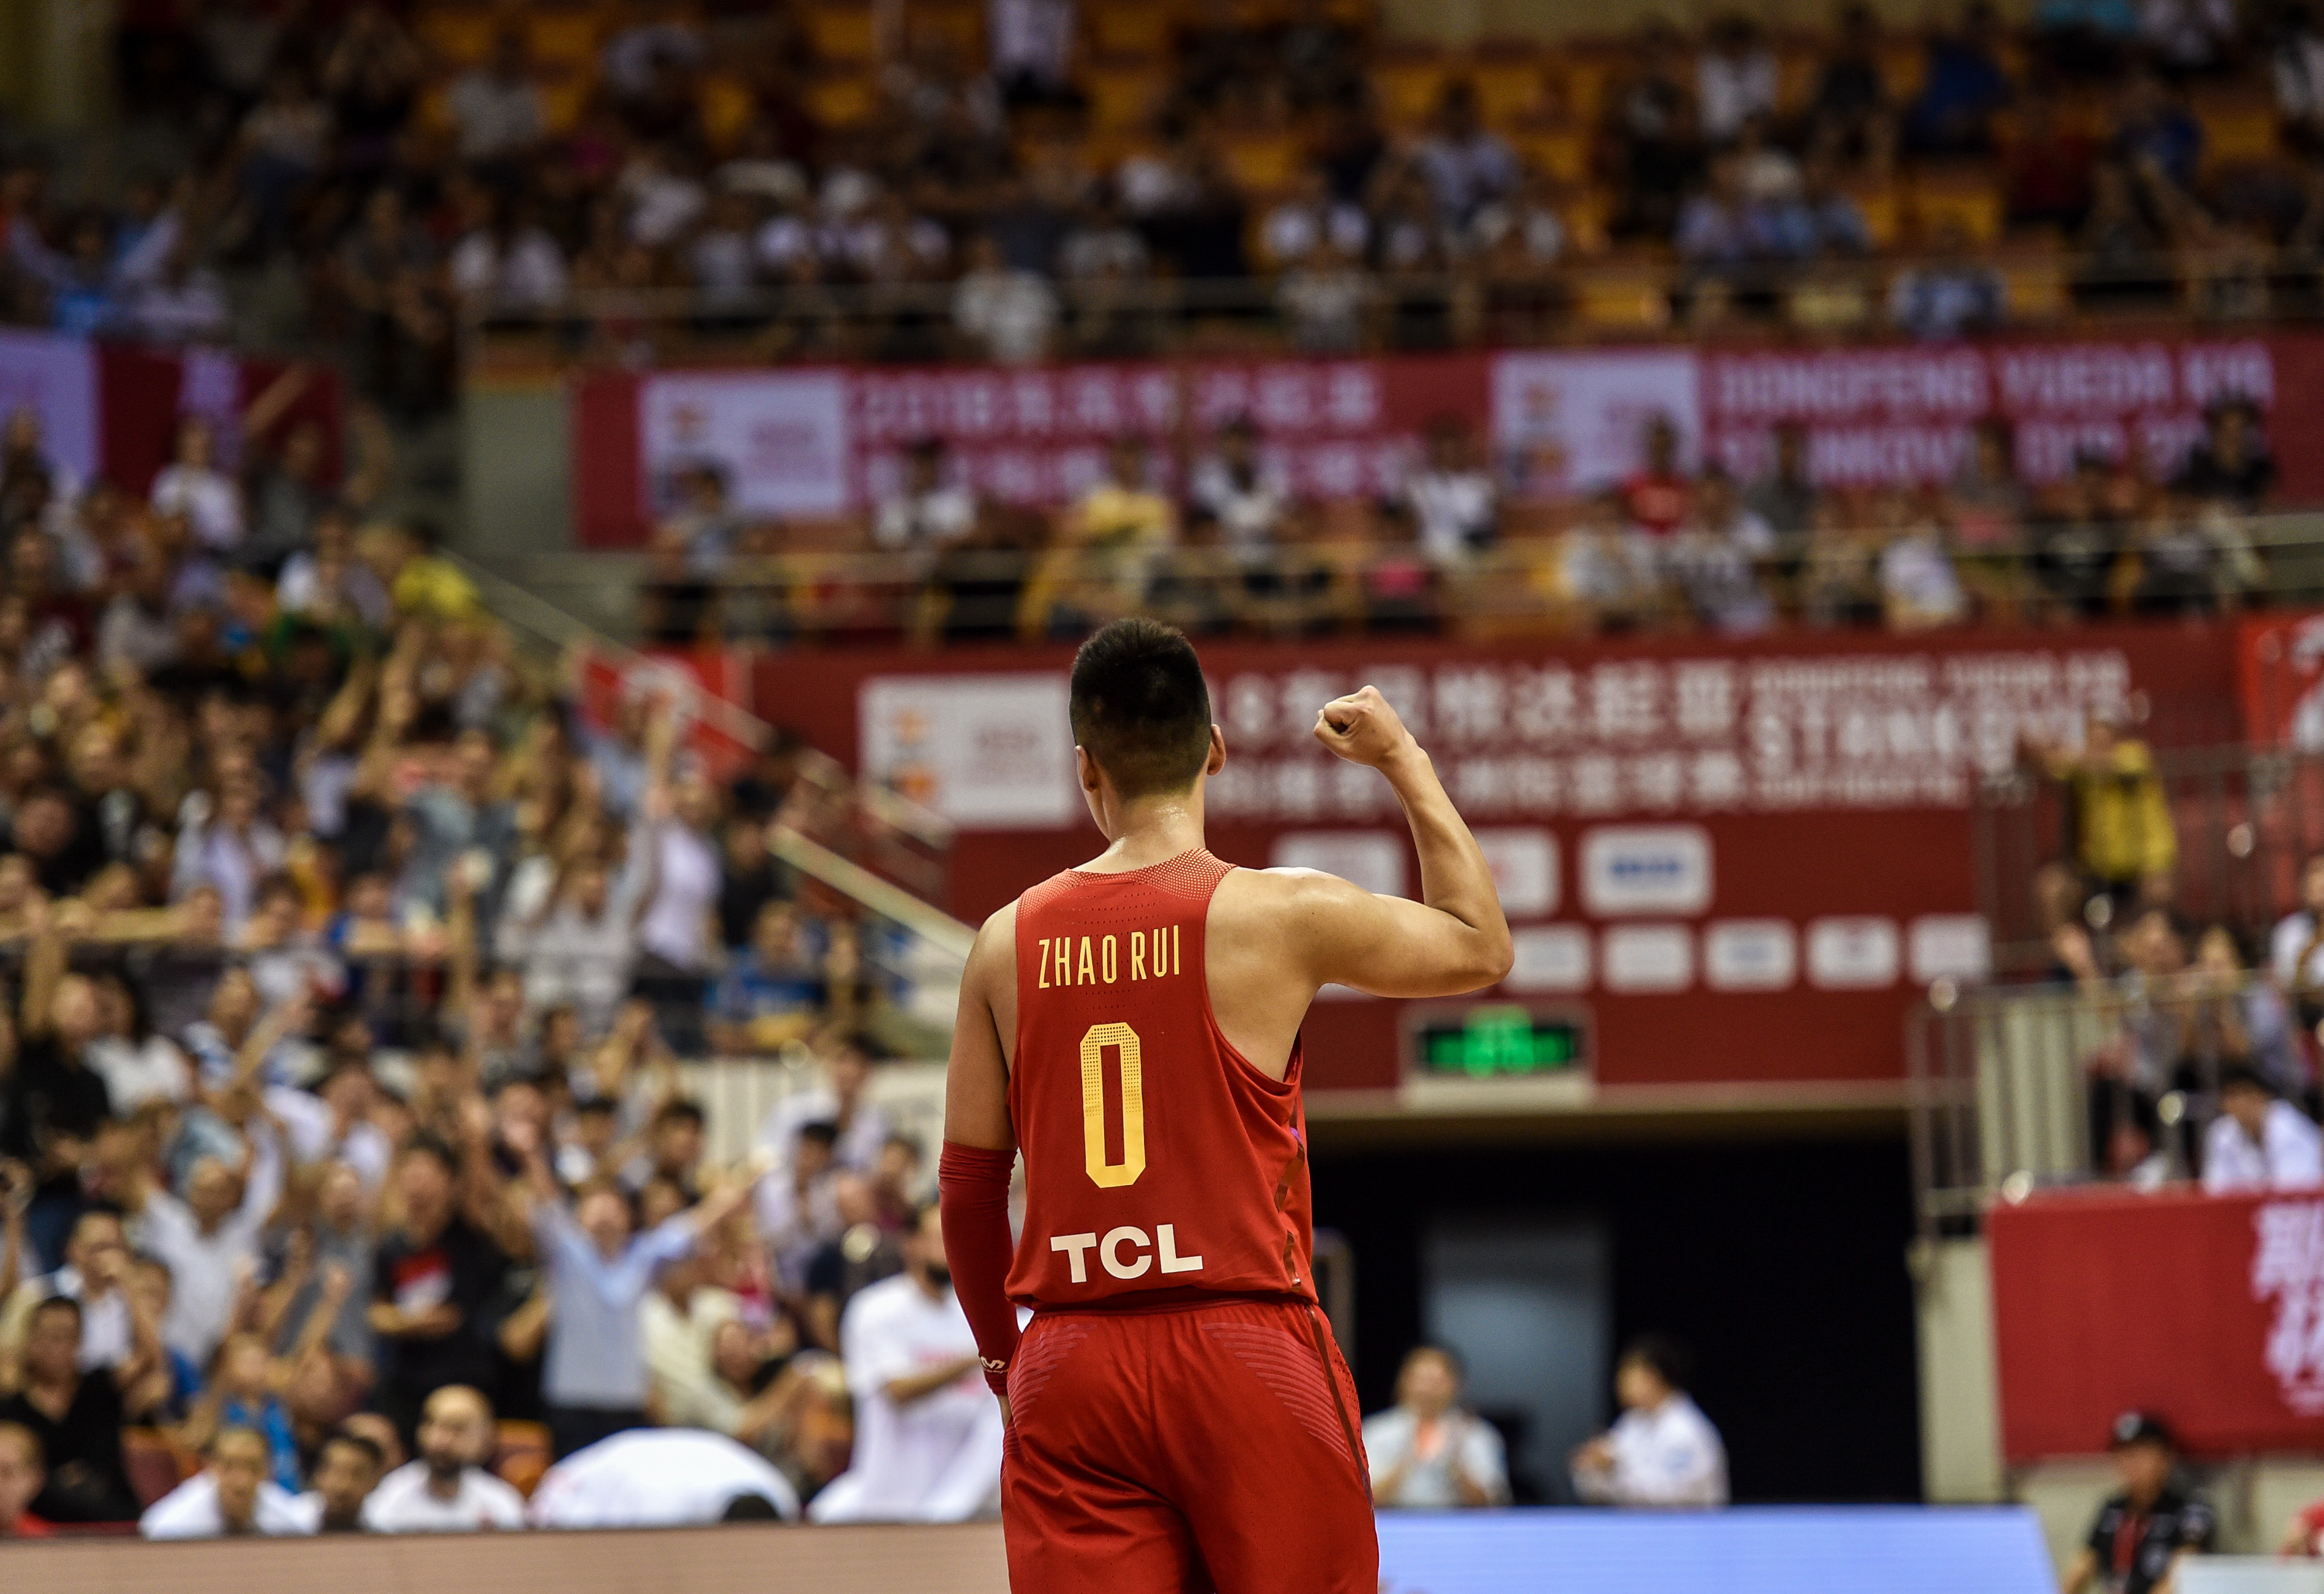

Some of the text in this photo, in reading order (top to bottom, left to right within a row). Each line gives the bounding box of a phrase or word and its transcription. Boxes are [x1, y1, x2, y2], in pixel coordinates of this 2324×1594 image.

[1038, 925, 1180, 989] ZHAO RUI
[1080, 1022, 1147, 1189] 0
[1050, 1223, 1204, 1284] TCL
